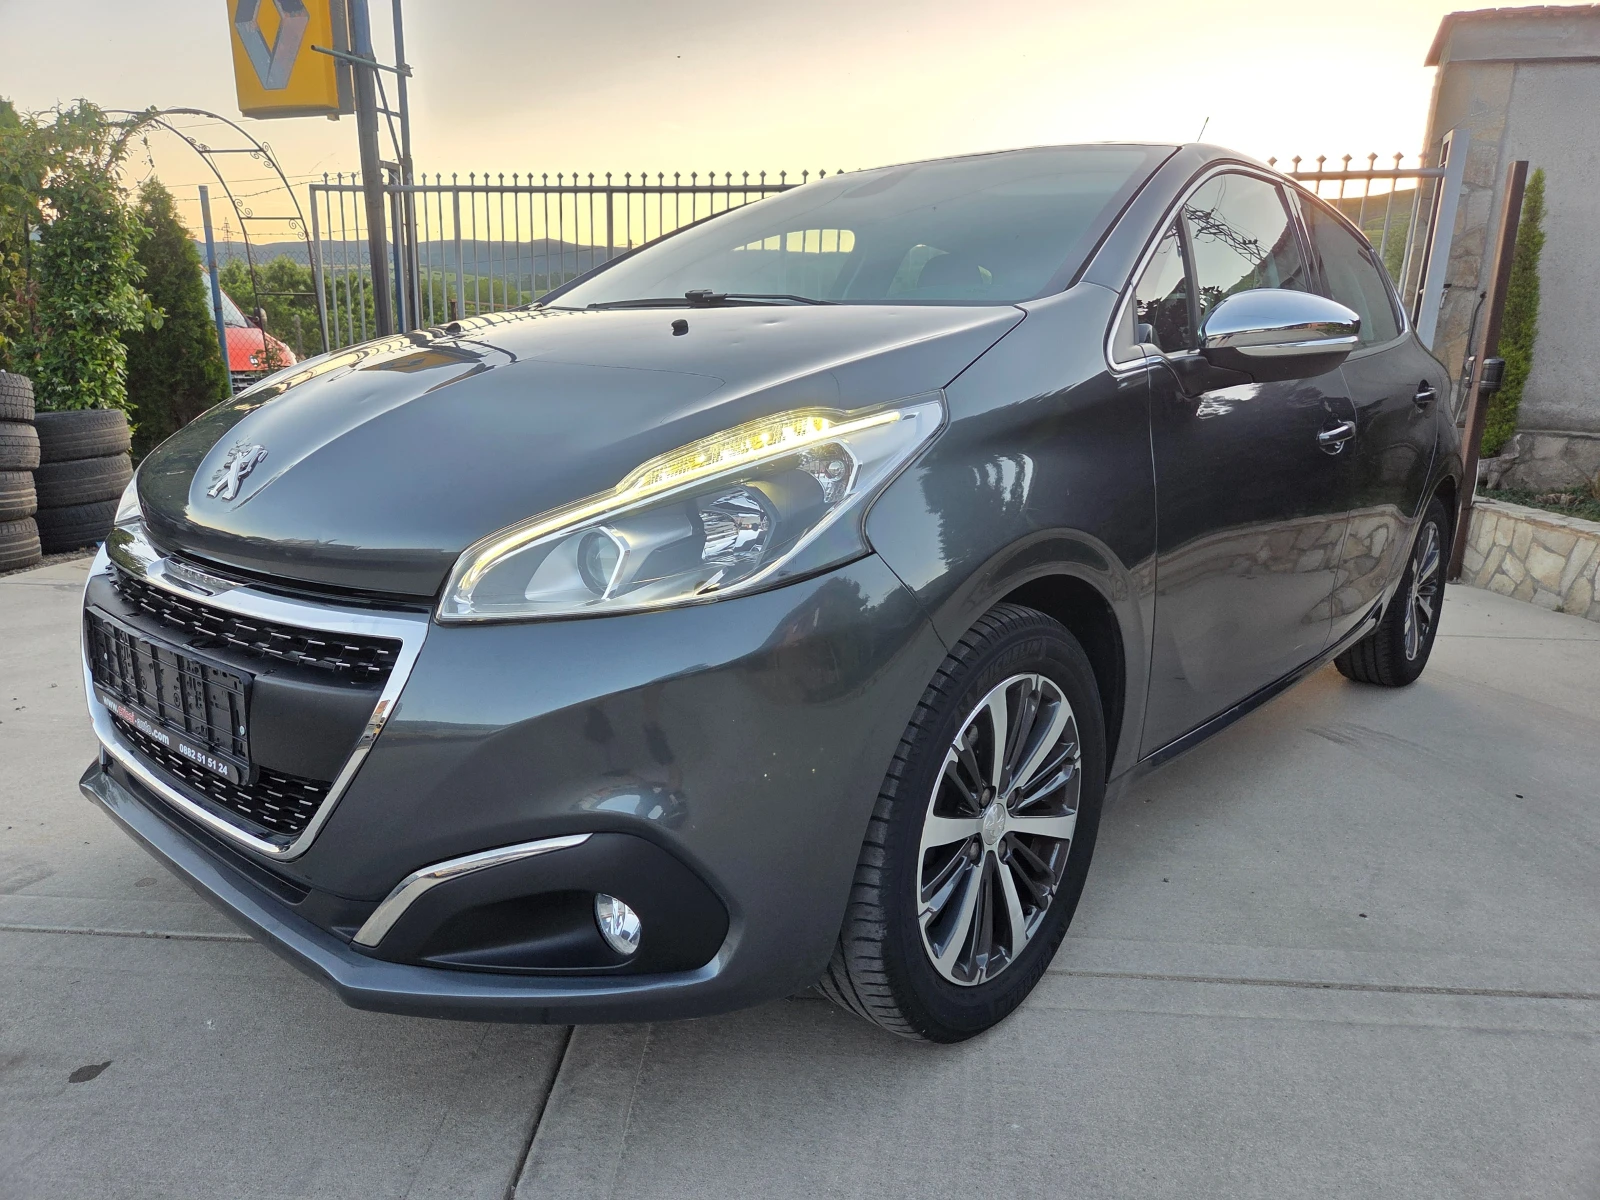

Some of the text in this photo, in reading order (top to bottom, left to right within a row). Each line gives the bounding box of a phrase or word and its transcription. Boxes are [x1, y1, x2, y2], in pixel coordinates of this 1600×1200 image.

[179, 743, 196, 760] 0882
[196, 752, 206, 765] 51
[207, 757, 216, 770] 51
[218, 762, 228, 776] 24
